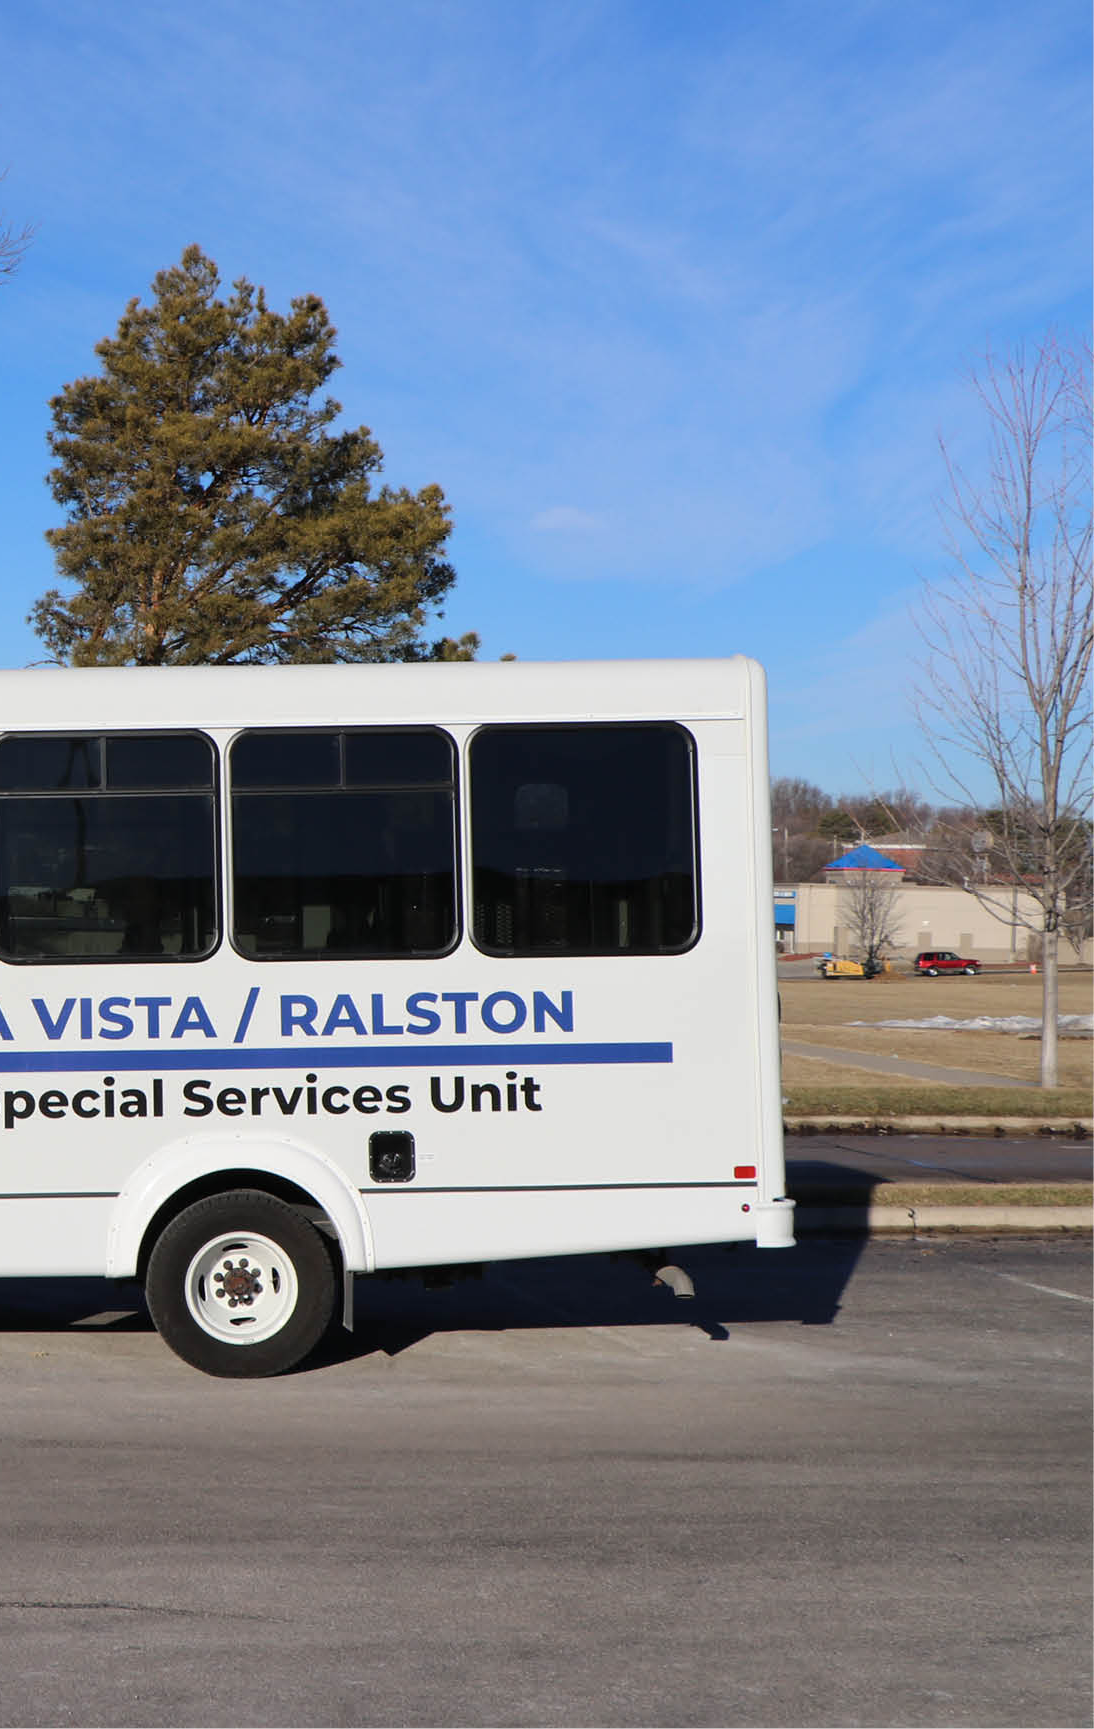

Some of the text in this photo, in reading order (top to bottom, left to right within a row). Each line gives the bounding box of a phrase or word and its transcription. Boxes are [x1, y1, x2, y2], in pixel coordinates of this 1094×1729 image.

[31, 996, 218, 1041] VISTA
[234, 986, 261, 1043] /
[279, 990, 574, 1037] RALSTON
[182, 1072, 412, 1118] Services
[431, 1071, 543, 1114] Unit
